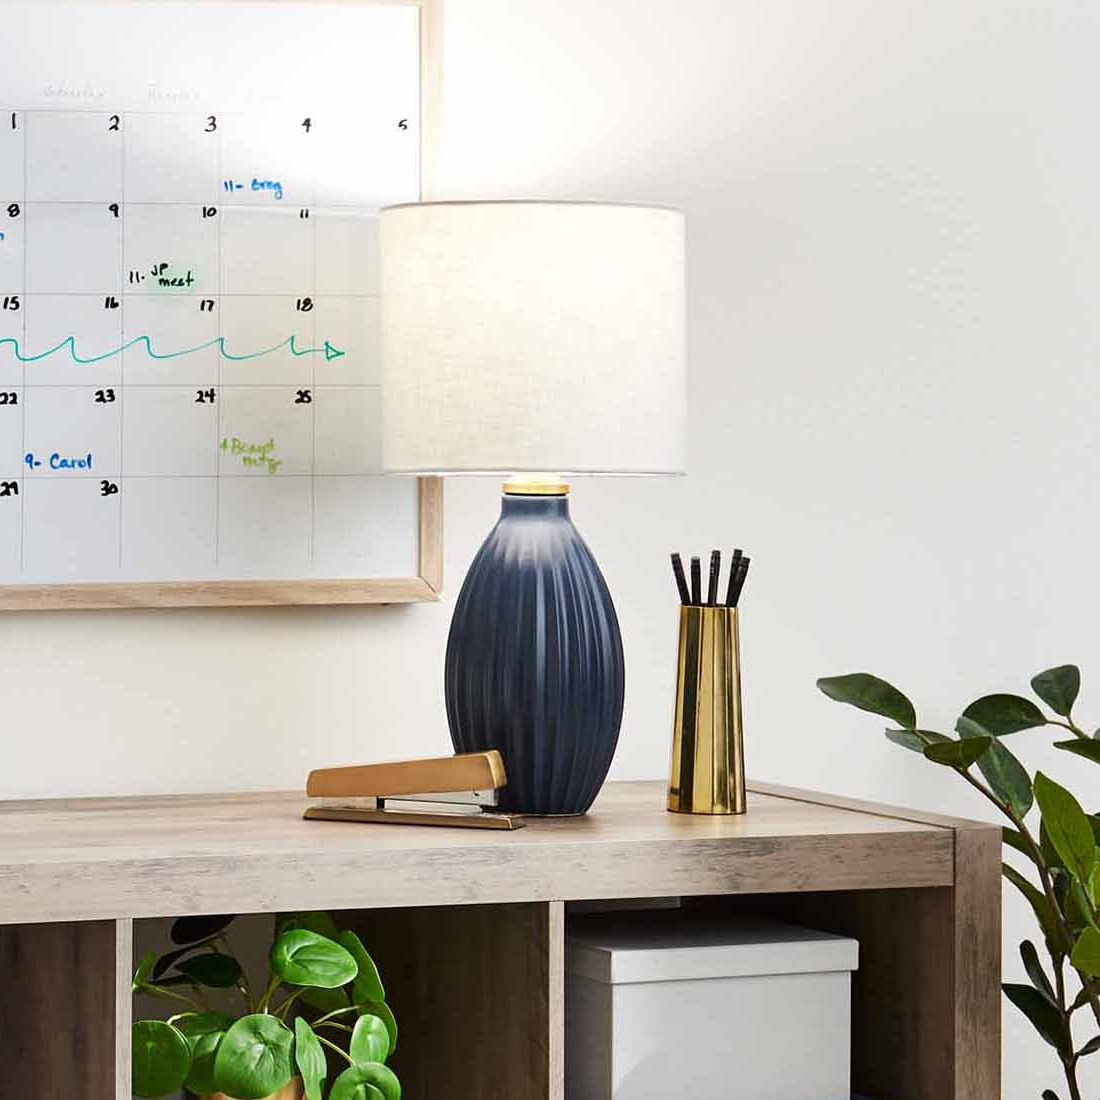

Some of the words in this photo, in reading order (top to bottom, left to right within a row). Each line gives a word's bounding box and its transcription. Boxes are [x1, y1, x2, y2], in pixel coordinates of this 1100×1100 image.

[109, 115, 119, 130] 2
[205, 116, 216, 132] 3
[302, 118, 311, 132] 4
[398, 120, 407, 130] 5
[7, 204, 20, 217] 8
[109, 204, 119, 217] 9
[203, 207, 217, 218] 10
[300, 209, 308, 218] 11
[151, 263, 168, 276] JP
[159, 271, 194, 287] meet
[4, 296, 19, 310] 15
[105, 297, 119, 308] 16
[201, 300, 214, 311] 17
[297, 298, 313, 311] 18
[95, 389, 115, 403] 23
[196, 388, 215, 403] 24
[295, 390, 312, 403] 25
[50, 453, 91, 469] Carol
[0, 481, 18, 496] 29
[101, 480, 118, 496] 30
